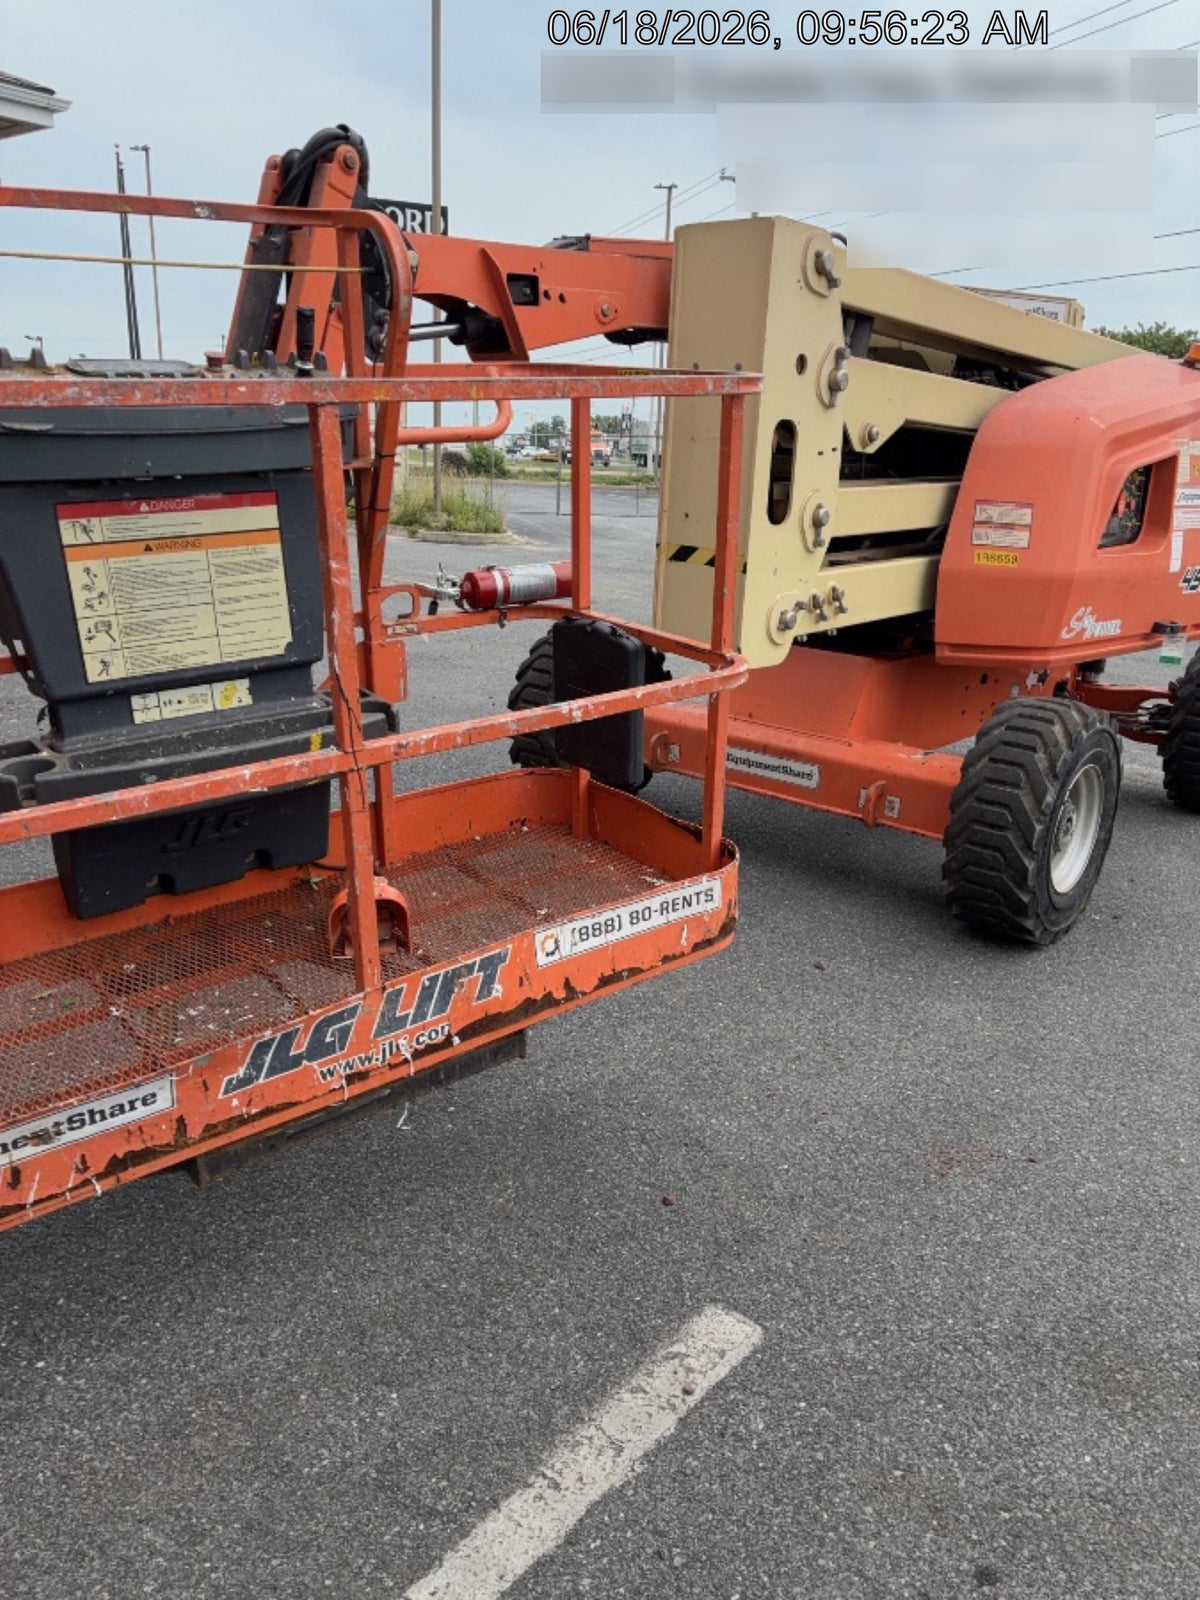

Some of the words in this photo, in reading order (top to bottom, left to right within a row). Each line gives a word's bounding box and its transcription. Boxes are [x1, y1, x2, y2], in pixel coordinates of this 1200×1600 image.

[384, 206, 445, 235] ORD
[150, 498, 196, 512] DANGER
[153, 539, 202, 551] WARNING
[160, 806, 254, 853] JLG
[571, 915, 622, 946] (888)
[629, 887, 714, 926] 80-RENTS
[218, 1001, 363, 1099] JLG
[370, 946, 512, 1039] LIFT
